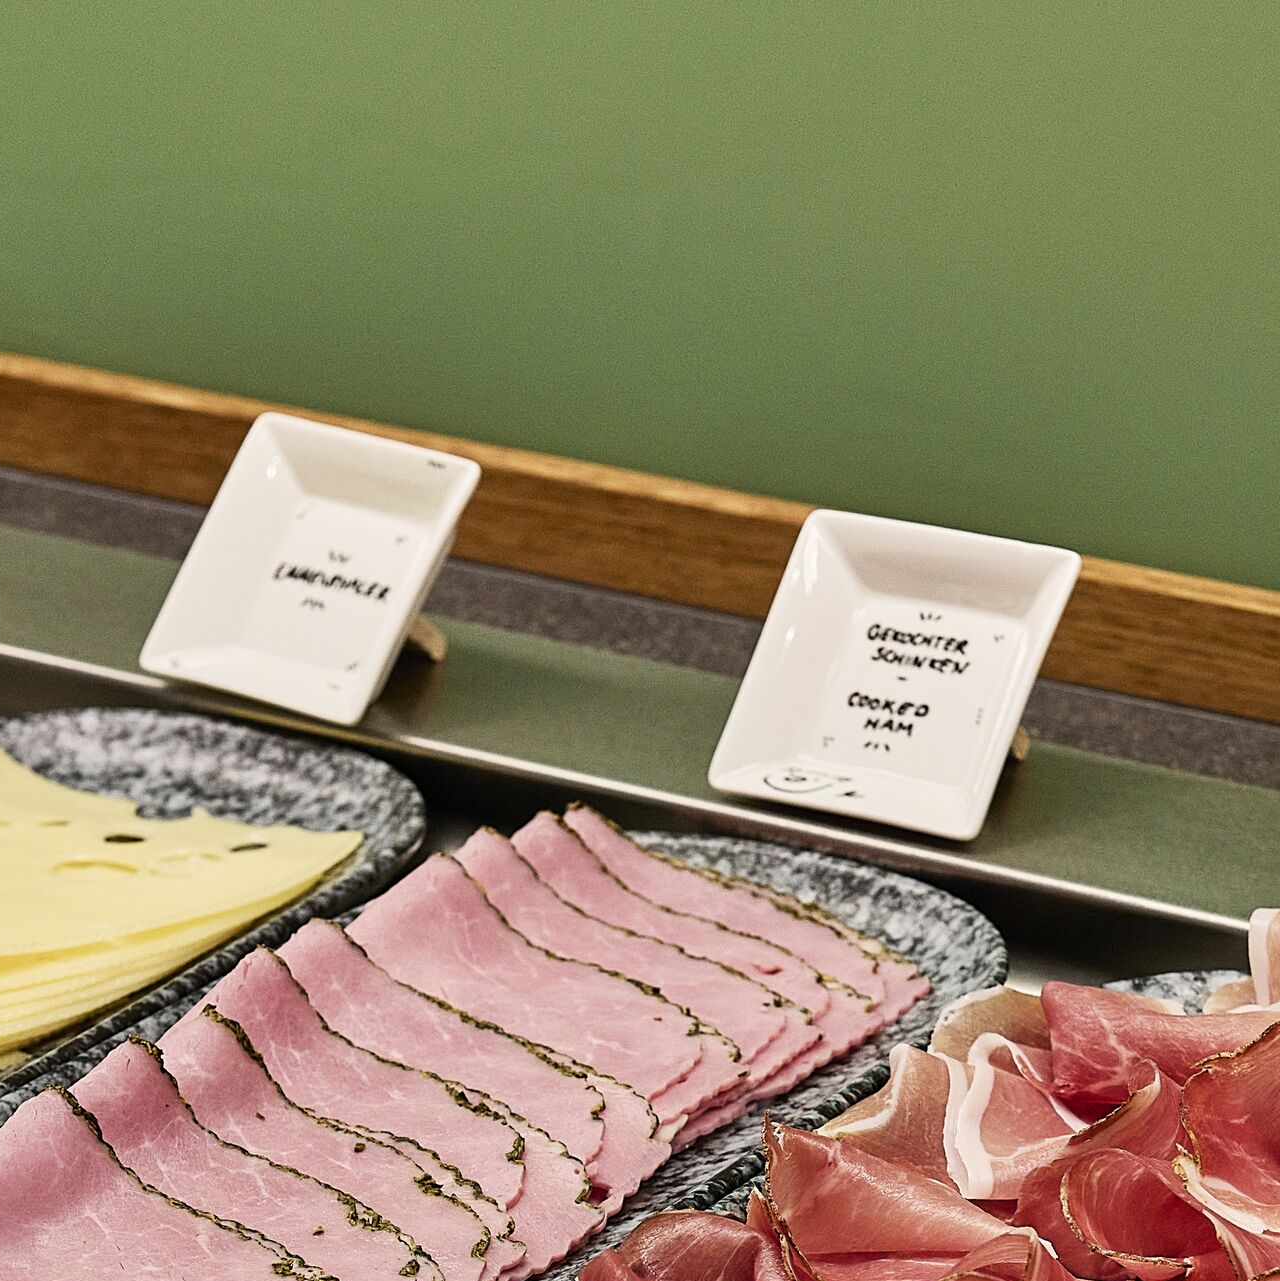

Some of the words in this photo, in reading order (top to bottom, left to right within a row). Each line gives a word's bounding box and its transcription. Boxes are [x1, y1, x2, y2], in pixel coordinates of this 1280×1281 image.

[866, 622, 970, 656] GEKOCHTER
[871, 647, 971, 676] SCHINKEN
[846, 690, 930, 719] COOKED
[863, 717, 914, 737] HAM
